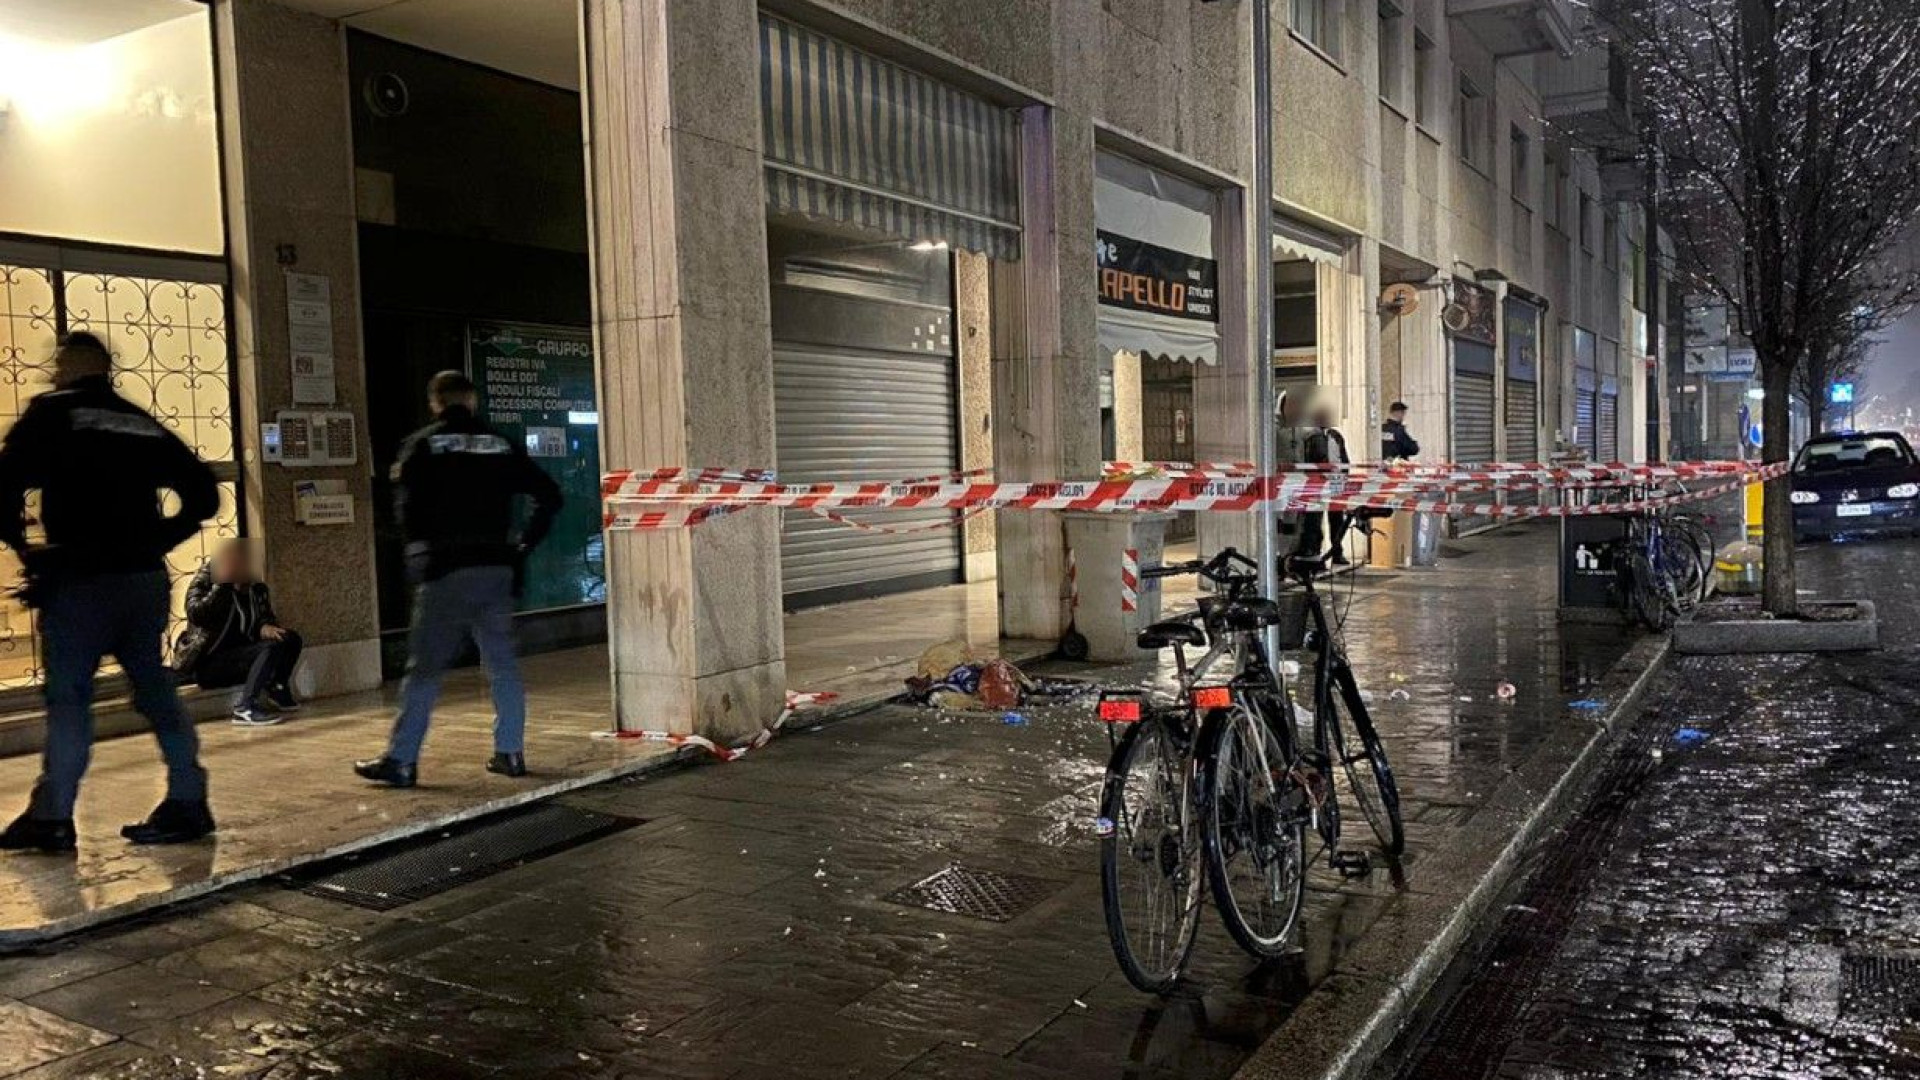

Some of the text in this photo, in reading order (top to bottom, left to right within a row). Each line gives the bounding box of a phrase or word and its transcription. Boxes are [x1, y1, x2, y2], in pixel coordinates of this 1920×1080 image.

[1099, 266, 1186, 312] APELLO
[537, 340, 590, 357] GRUPPO
[486, 356, 547, 369] REGISTRI IVA
[487, 370, 518, 383] BOLLE
[487, 384, 560, 397] MODULI FISCALI
[488, 399, 593, 412] ACCESSORI COMPUTER
[488, 412, 522, 424] TIMBRI
